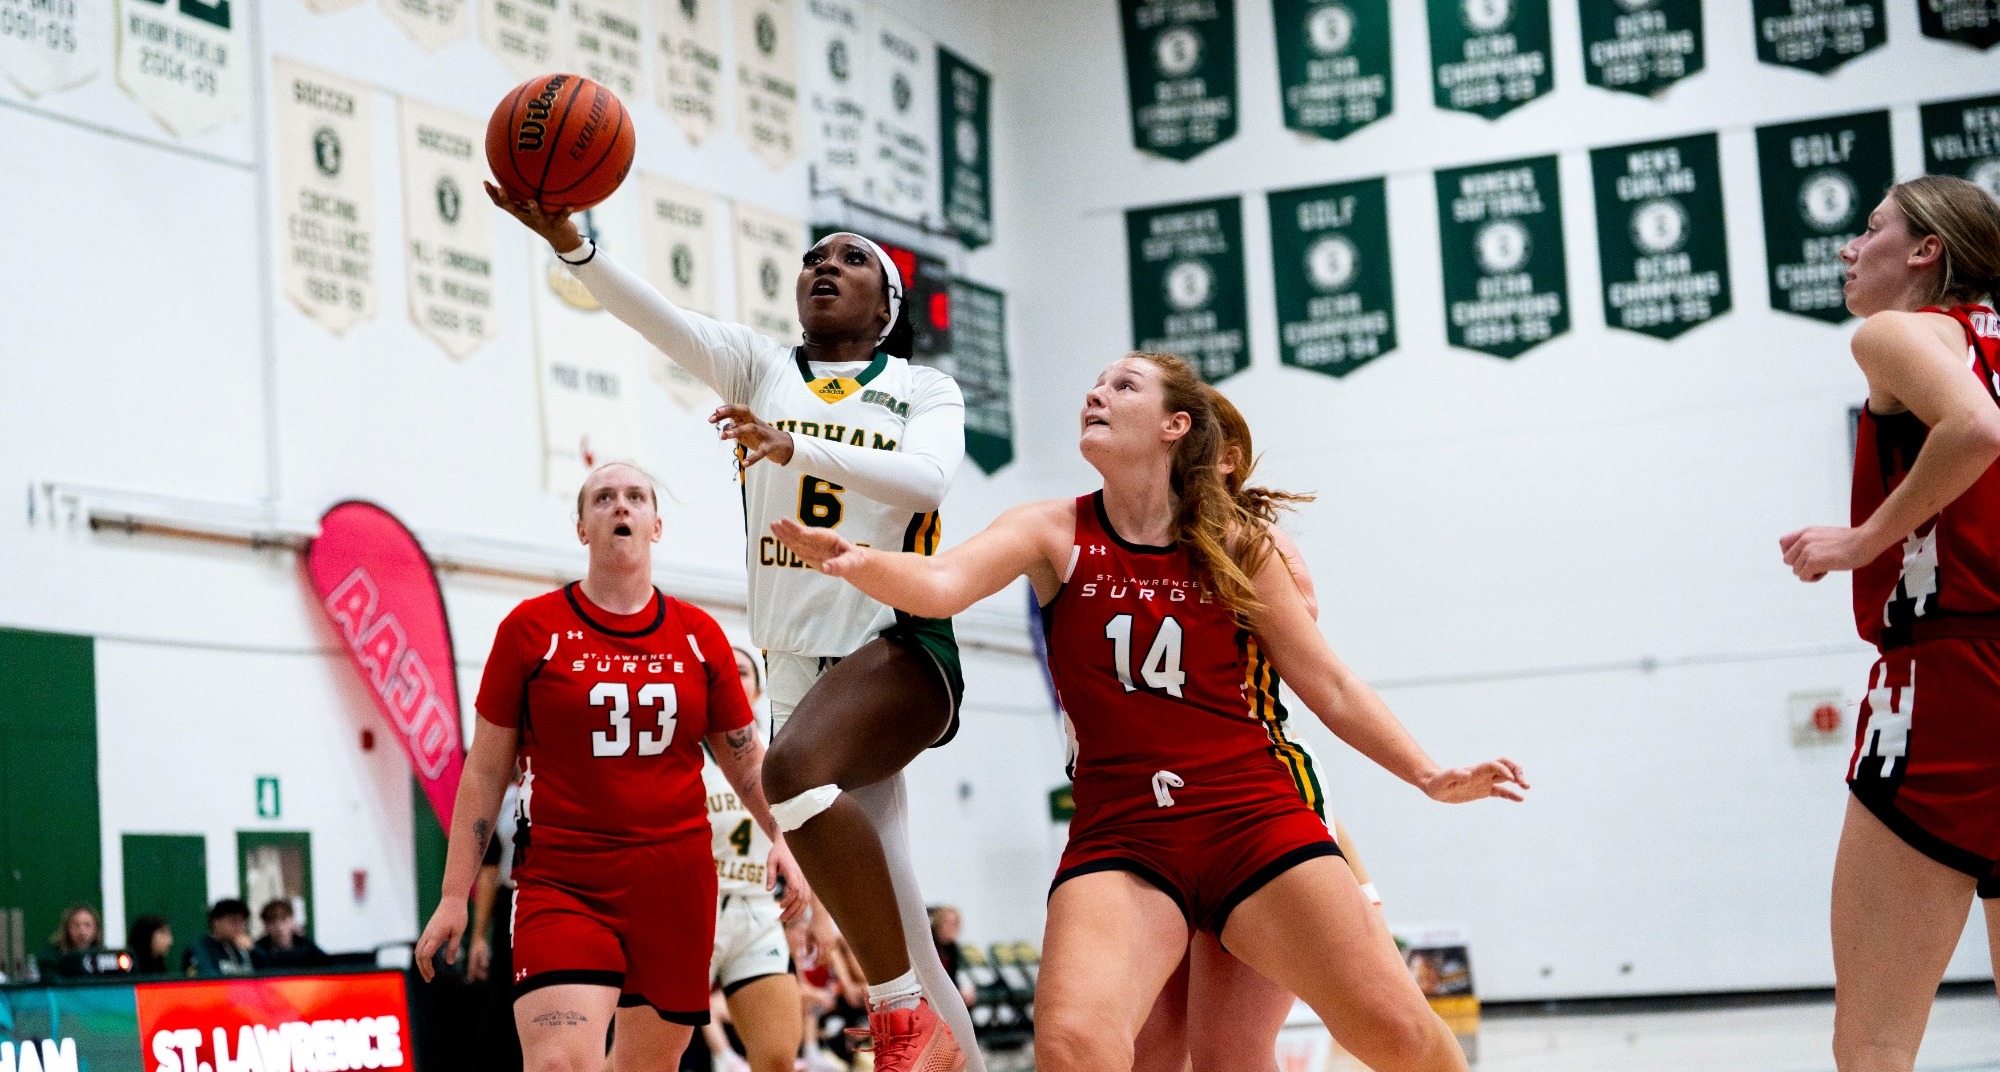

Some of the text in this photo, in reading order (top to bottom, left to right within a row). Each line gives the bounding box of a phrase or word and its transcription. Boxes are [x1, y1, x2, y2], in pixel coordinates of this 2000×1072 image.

[1762, 4, 1874, 43] CHAMPIONS
[1590, 29, 1695, 67] CHAMPIONS
[1438, 50, 1545, 89] CHAMPIONS
[1287, 74, 1386, 109] CHAMPIONS
[517, 74, 571, 153] Wilson
[1789, 128, 1857, 169] GOLF
[1615, 166, 1697, 201] CURLING
[1297, 194, 1358, 232] GOLF
[1608, 270, 1721, 308] CHAMPIONS
[1283, 309, 1390, 346] CHAMPIONS
[1452, 291, 1561, 327] CHAMPIONS
[860, 389, 910, 420] OCAA
[796, 473, 846, 529] 6
[1096, 574, 1199, 588] ST. LAWRENCE
[572, 660, 685, 674] SURGE
[1105, 614, 1186, 698] 14
[588, 682, 678, 757] 33
[729, 817, 753, 856] 4
[152, 1015, 404, 1072] ST. LAWRENCE
